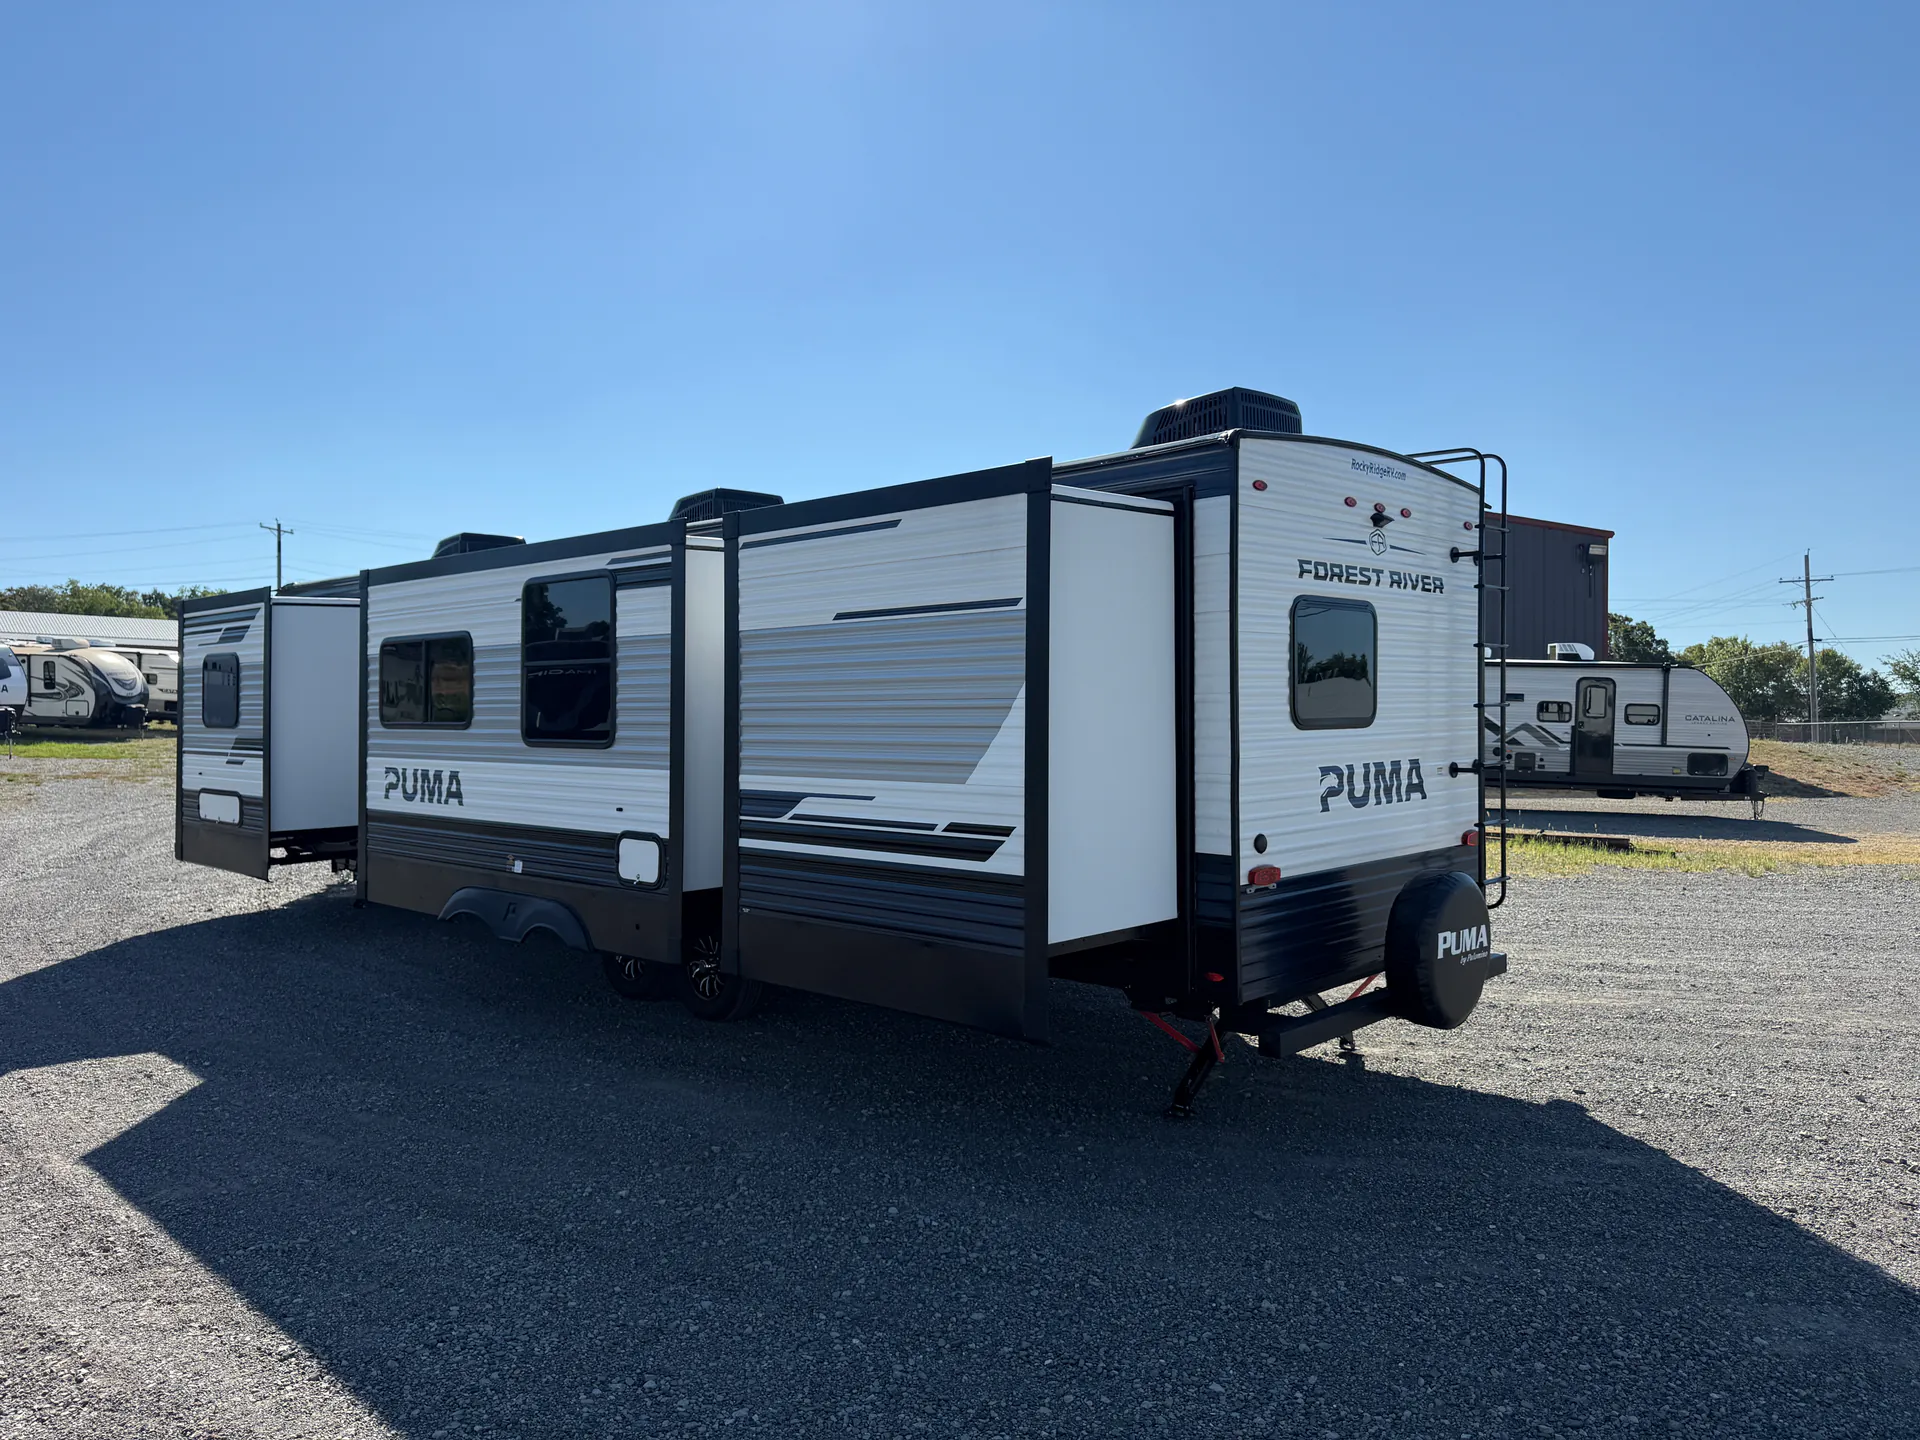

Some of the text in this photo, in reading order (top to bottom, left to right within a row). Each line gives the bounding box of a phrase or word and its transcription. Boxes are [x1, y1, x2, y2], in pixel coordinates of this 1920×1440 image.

[1351, 458, 1407, 481] RockyRidgeRV.com
[1297, 558, 1445, 594] FOREST RIVER
[1685, 714, 1736, 723] CATALINA
[384, 766, 464, 807] PUMA
[1318, 758, 1428, 814] PUMA
[1437, 924, 1489, 960] PUMA
